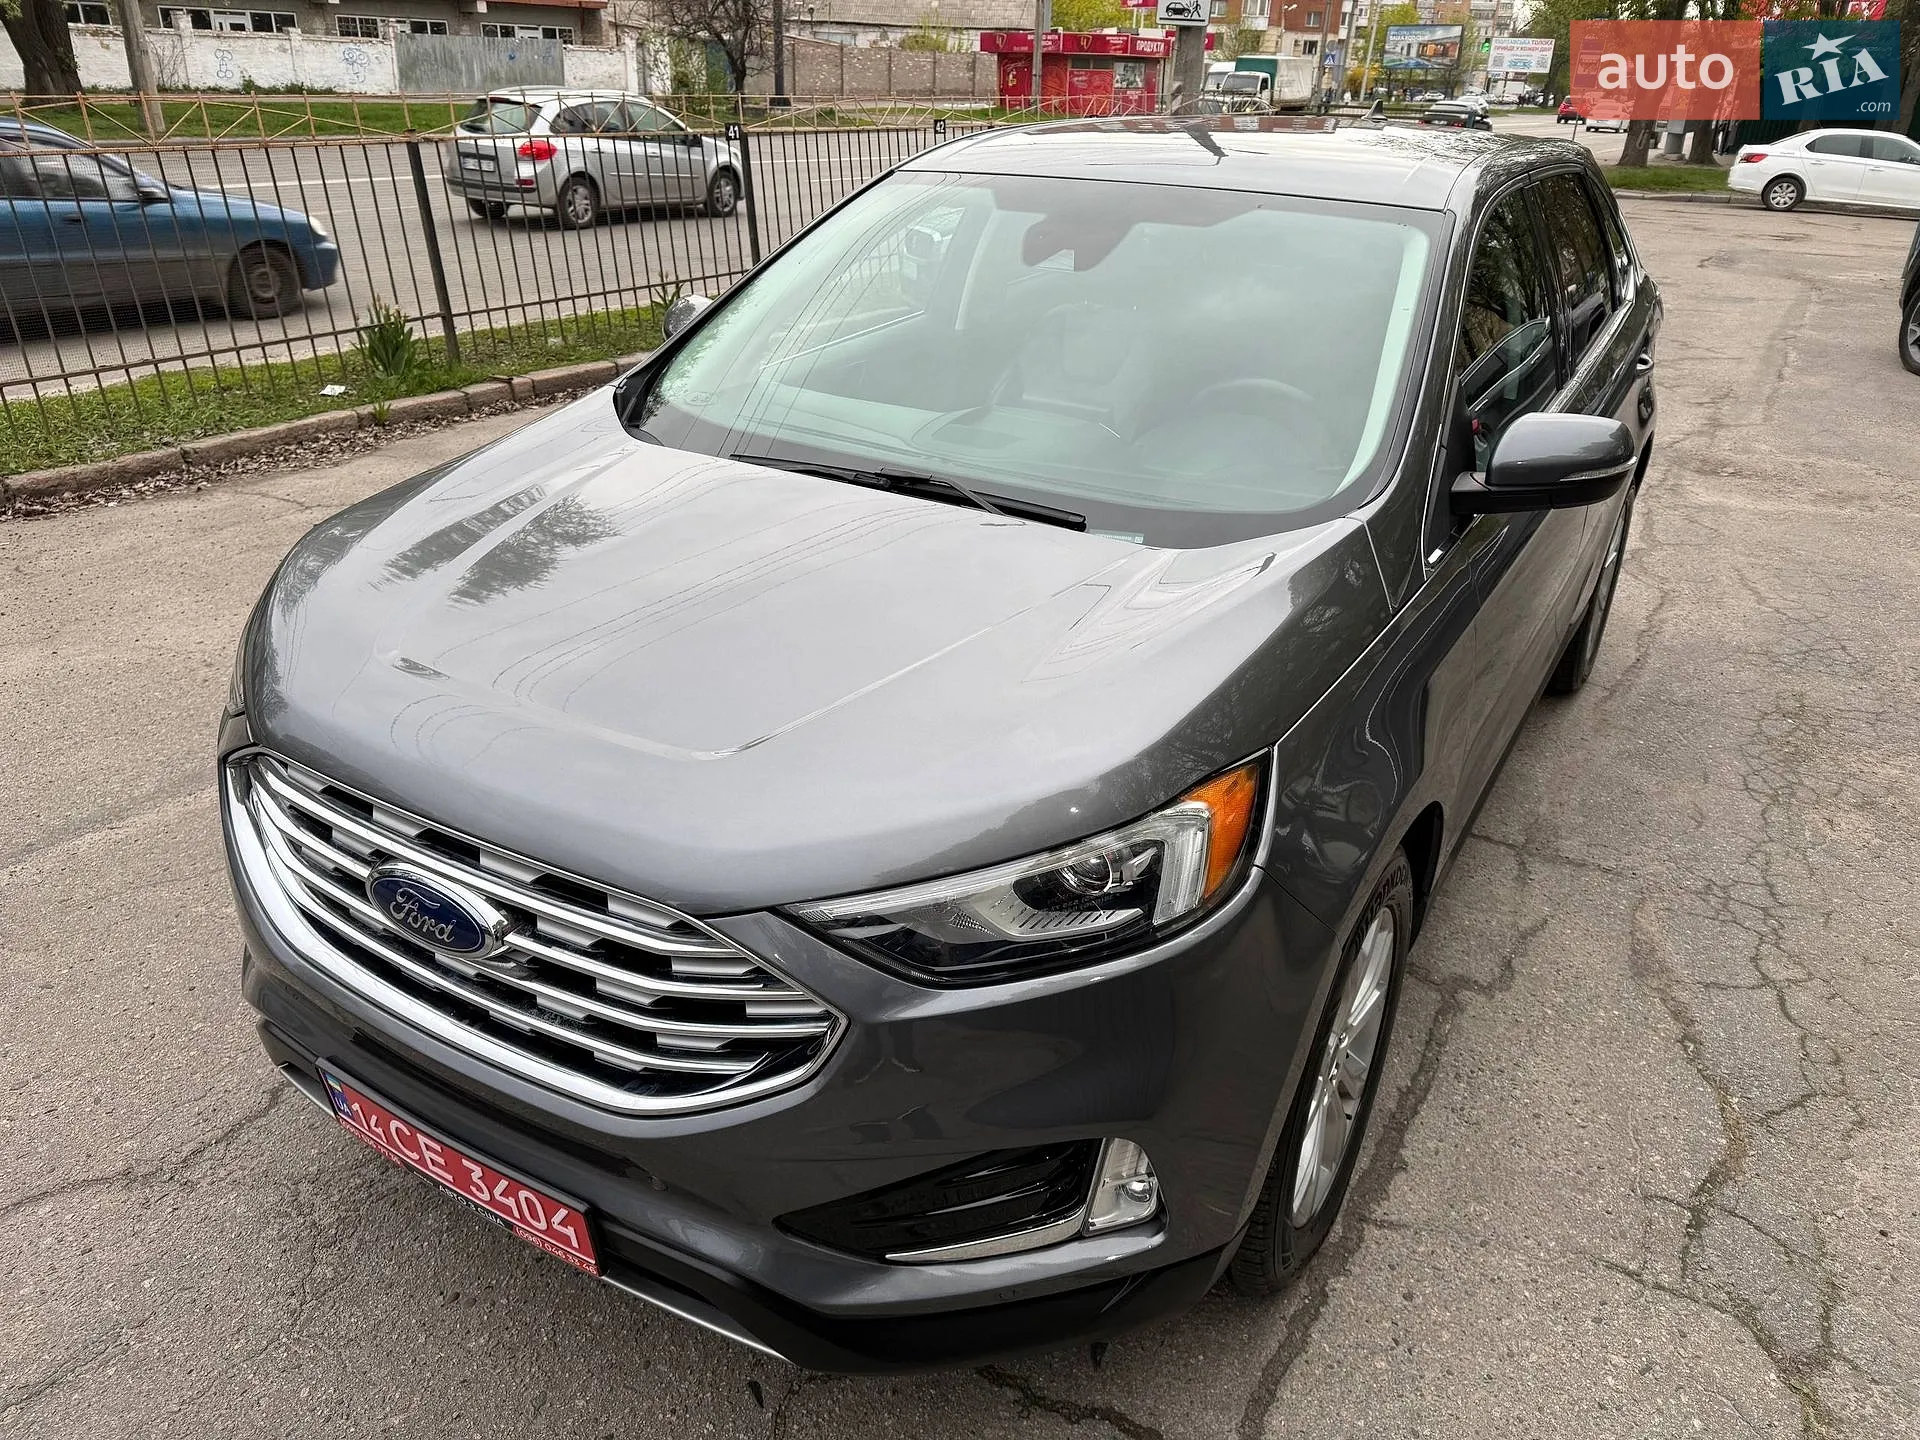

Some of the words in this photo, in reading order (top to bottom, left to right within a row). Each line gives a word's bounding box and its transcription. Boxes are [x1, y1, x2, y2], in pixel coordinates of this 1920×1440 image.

[1136, 40, 1165, 53] ПРОДУКТИ
[728, 124, 740, 139] 41
[935, 120, 945, 133] 42
[389, 887, 457, 943] Ford
[334, 1096, 352, 1117] UA
[439, 1184, 467, 1206] АВТО
[461, 1158, 580, 1249] 3404
